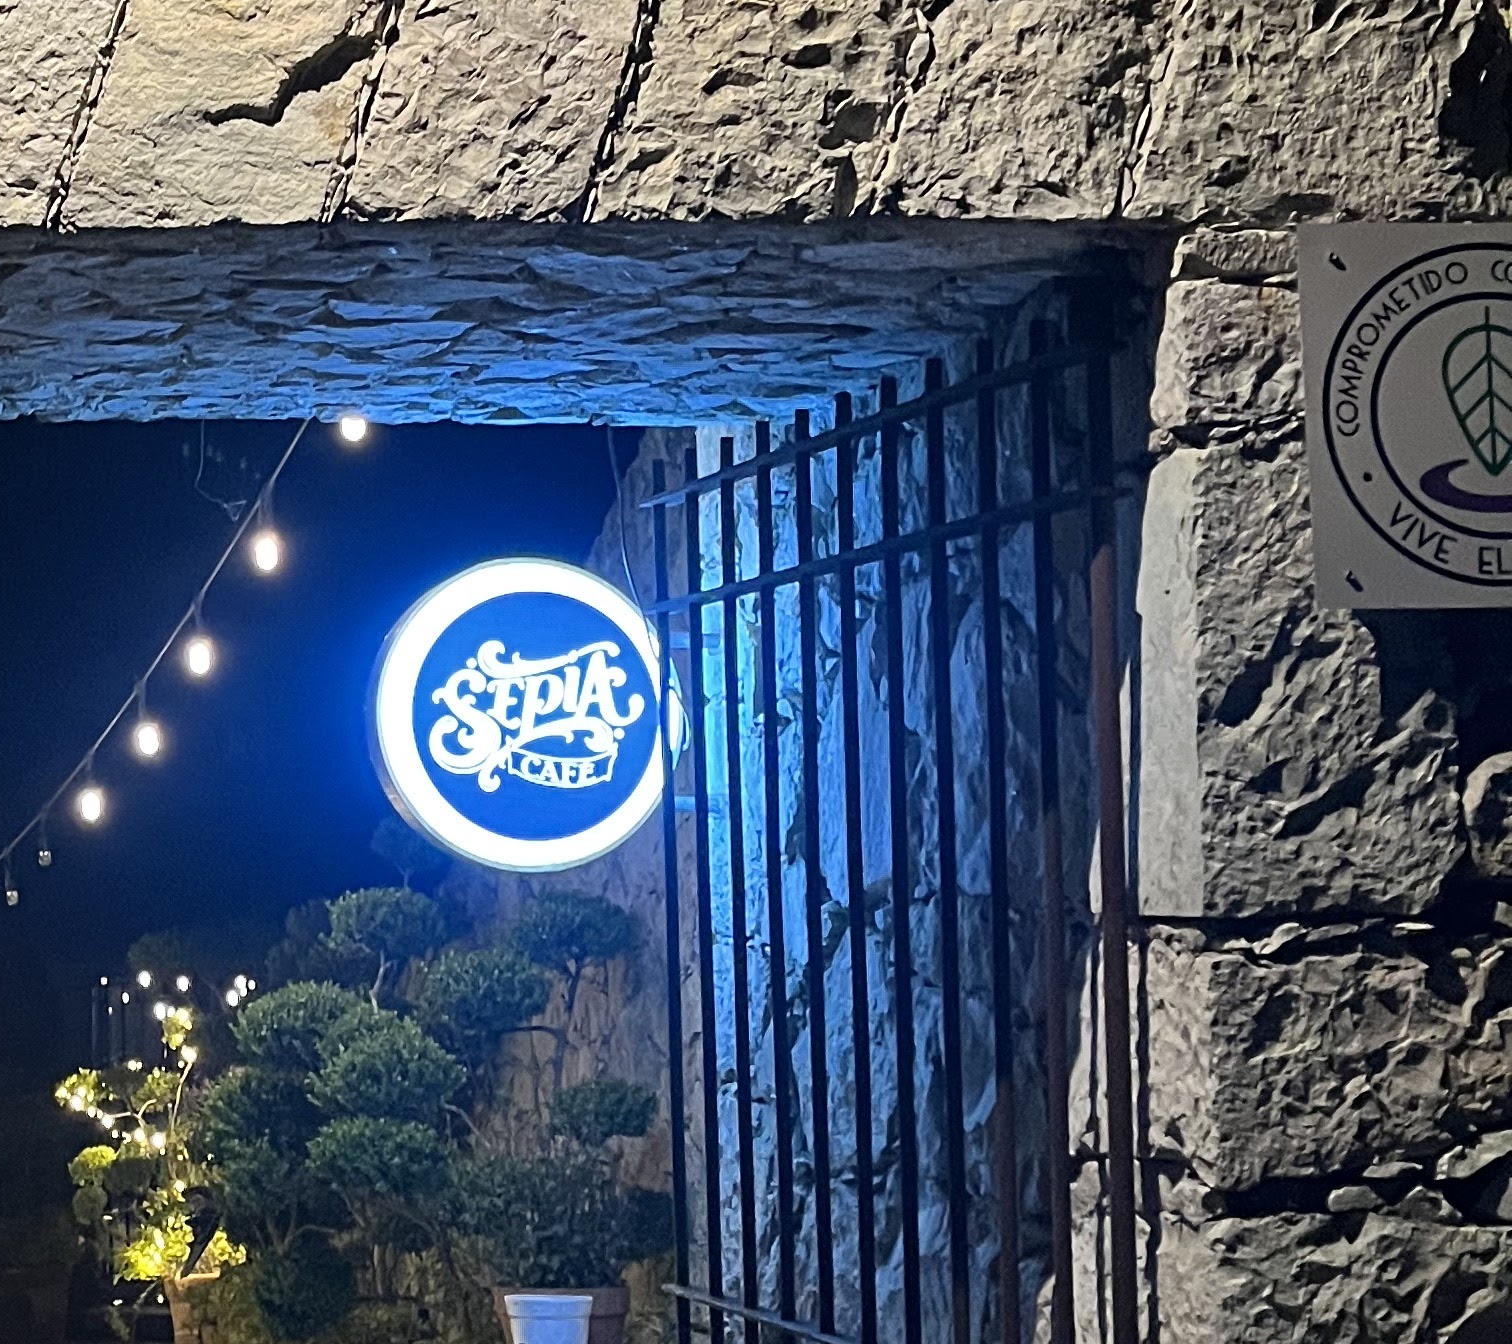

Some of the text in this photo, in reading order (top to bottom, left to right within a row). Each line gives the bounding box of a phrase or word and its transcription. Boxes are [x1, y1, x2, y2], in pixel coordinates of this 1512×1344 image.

[1336, 261, 1468, 437] COMPROMETIDO
[1389, 500, 1512, 575] VIVE EL
[429, 640, 645, 792] SEPIA
